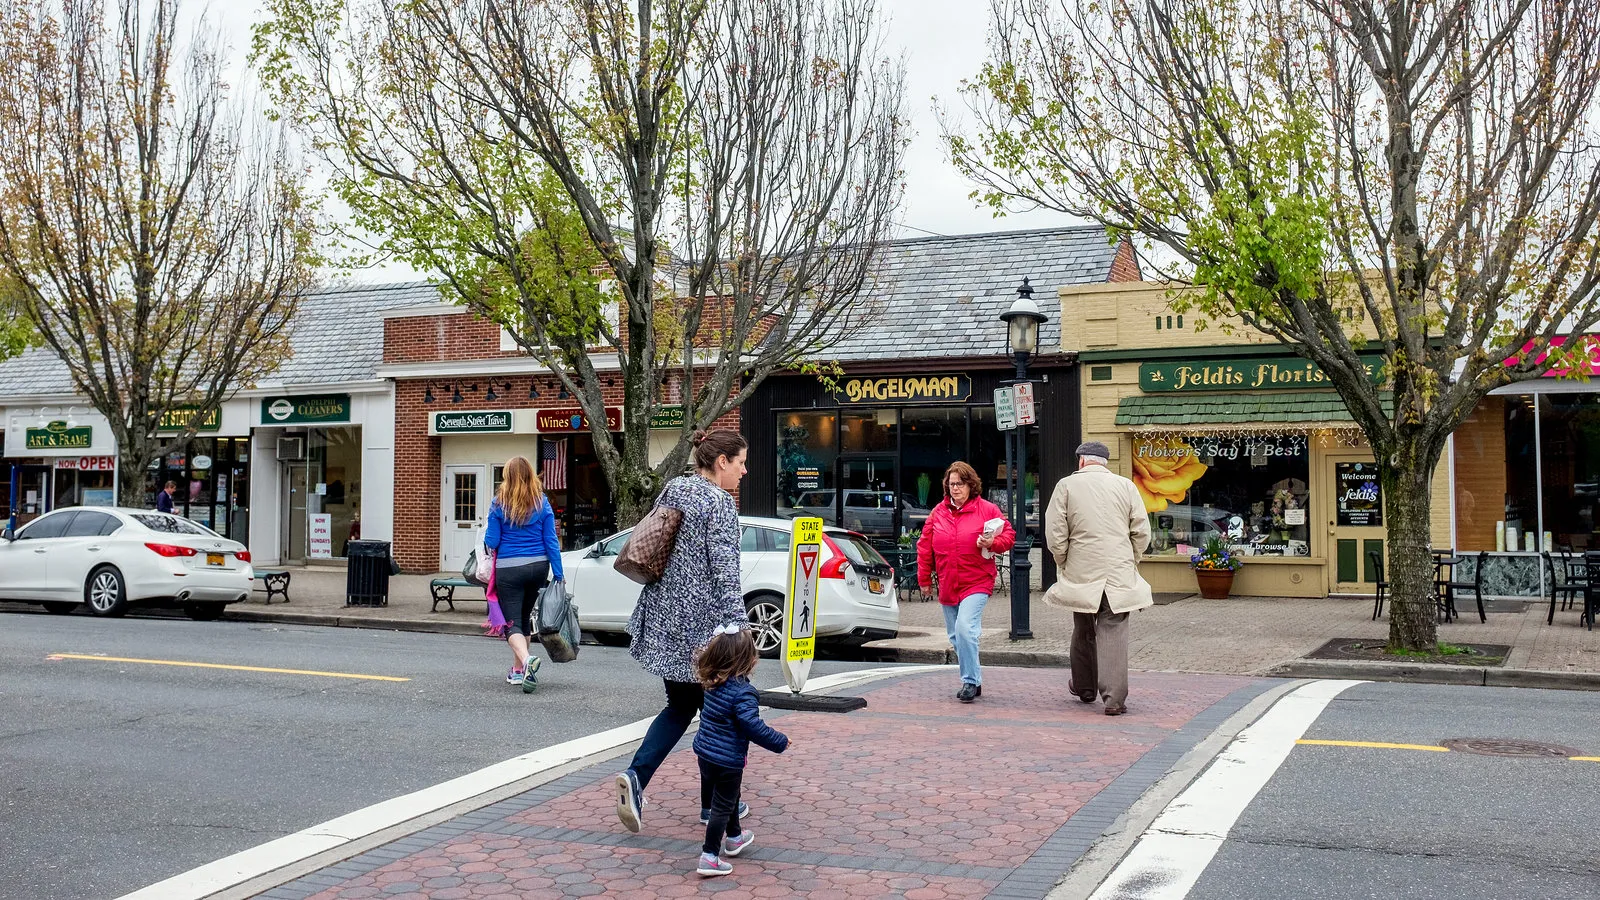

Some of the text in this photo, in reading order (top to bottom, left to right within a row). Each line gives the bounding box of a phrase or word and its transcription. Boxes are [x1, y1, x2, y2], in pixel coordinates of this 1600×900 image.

[1173, 365, 1244, 389] Feldis
[845, 376, 958, 402] BAGELMAN
[1016, 396, 1032, 404] STOPPING
[297, 403, 343, 415] CLEANERS
[670, 409, 684, 419] City
[438, 413, 507, 428] Seventh Street Travel
[540, 416, 569, 428] Wines
[28, 433, 88, 446] ART & FRAME
[1138, 444, 1301, 460] Flowers Say It Best
[58, 456, 115, 470] NOW OPEN
[1339, 488, 1379, 502] feldis
[801, 521, 819, 531] STATE
[803, 533, 816, 541] LAW
[803, 588, 810, 596] TO
[790, 649, 812, 657] CROSSWALK
